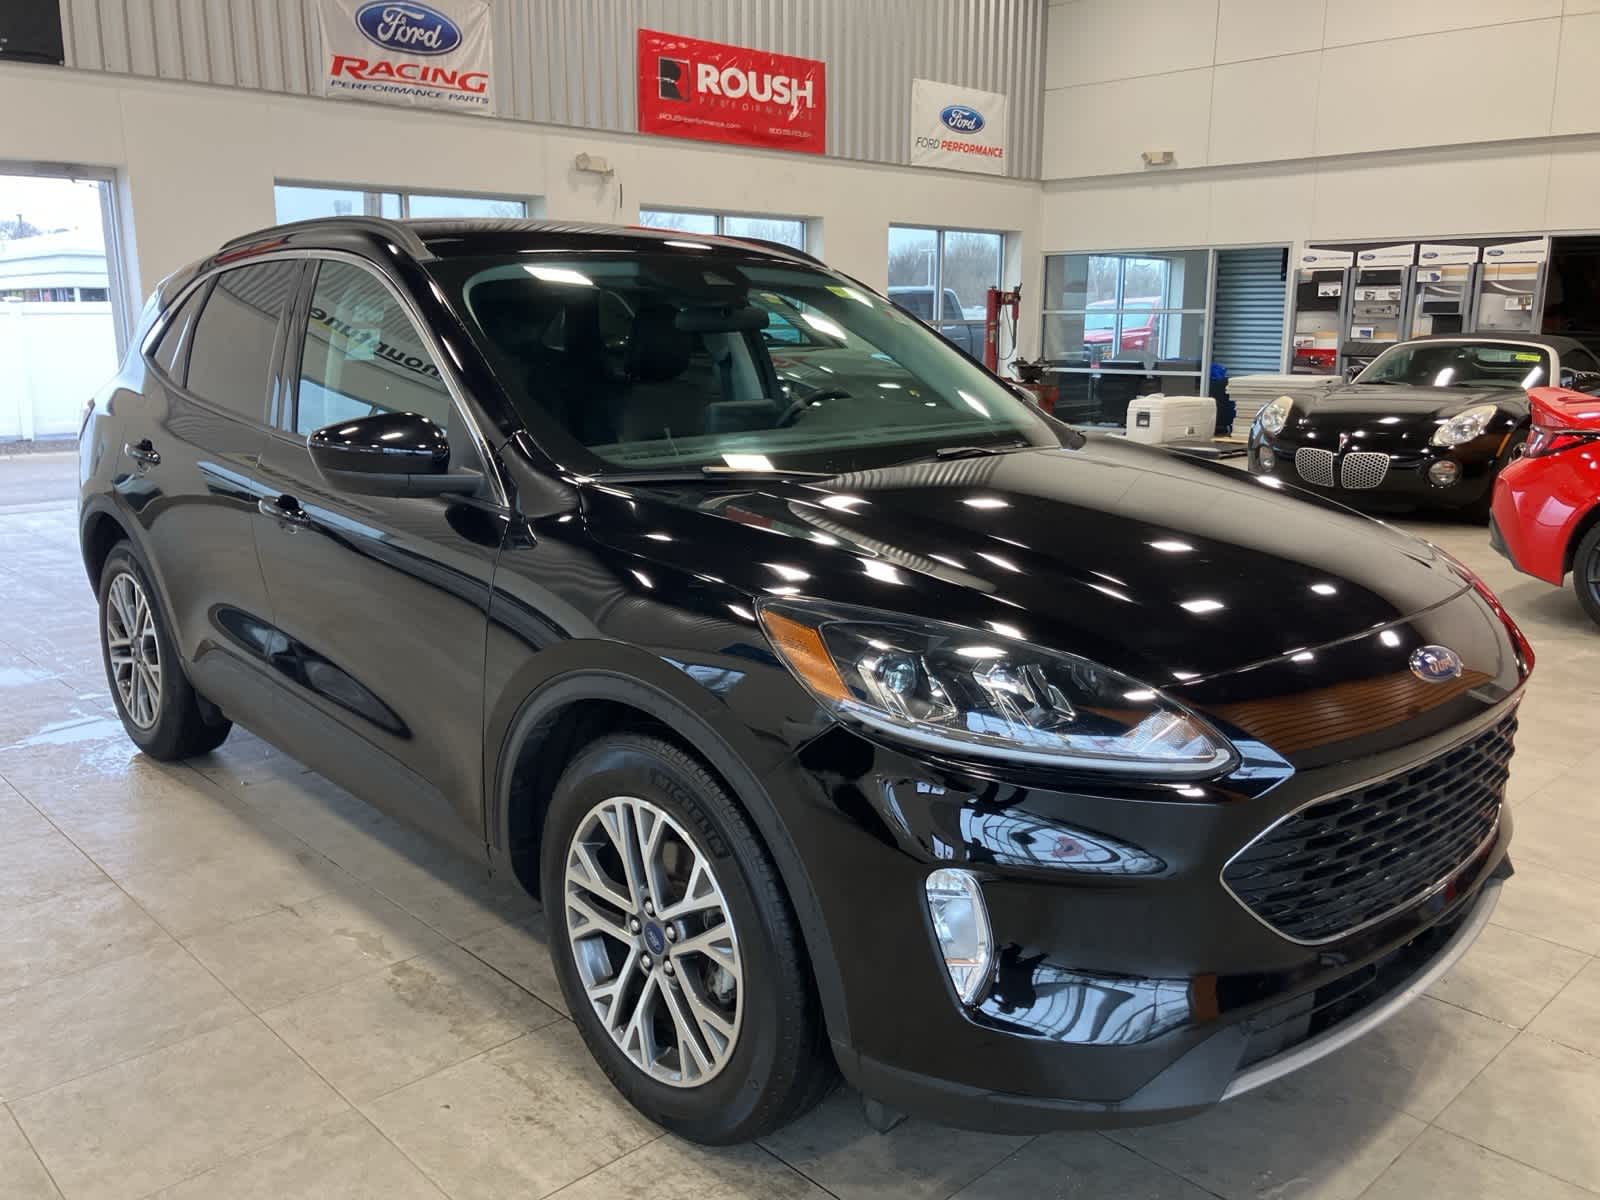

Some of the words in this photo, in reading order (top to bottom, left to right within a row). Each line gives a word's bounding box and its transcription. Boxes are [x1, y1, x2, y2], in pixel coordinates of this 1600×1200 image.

[377, 6, 442, 49] Ford
[330, 55, 489, 93] RACING
[330, 80, 442, 98] PERFORMANCE
[448, 94, 489, 104] PARTS
[697, 63, 815, 121] ROUSH
[948, 109, 977, 130] Ford
[915, 136, 941, 149] FORD
[941, 140, 1004, 158] PERFORMANCE
